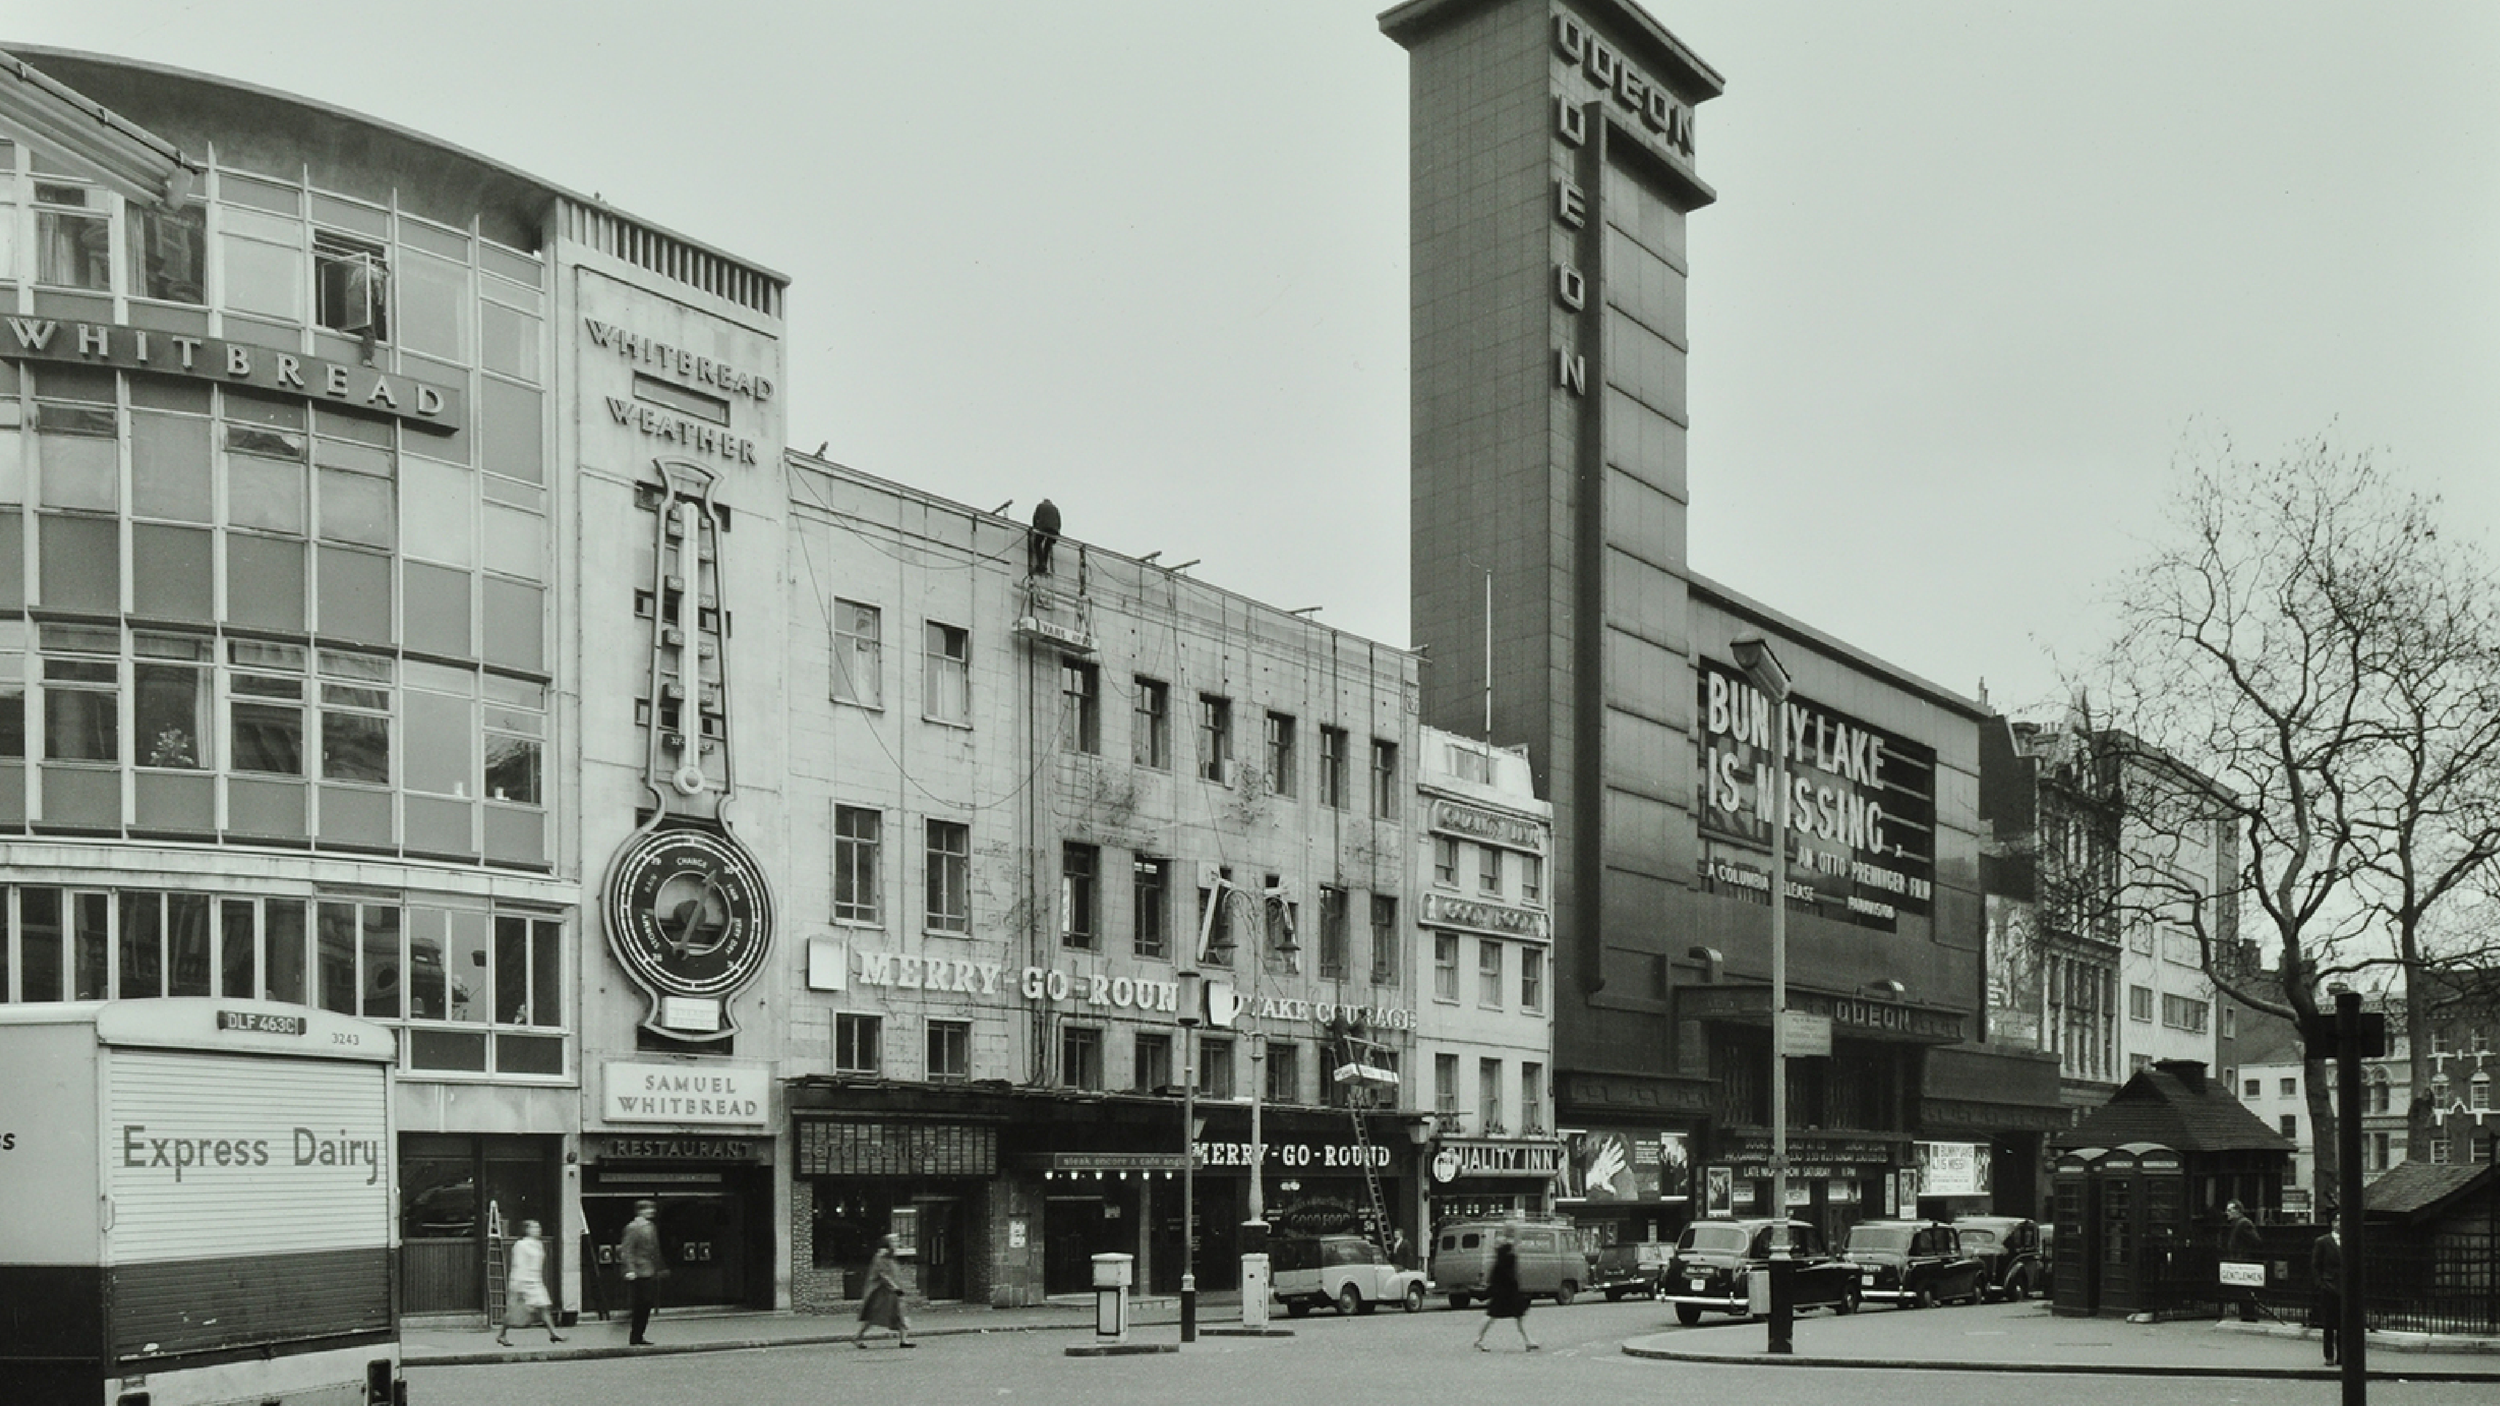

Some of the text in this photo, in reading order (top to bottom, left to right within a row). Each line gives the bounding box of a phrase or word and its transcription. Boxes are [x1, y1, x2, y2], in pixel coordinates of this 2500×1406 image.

[1558, 12, 1695, 157] ODEON
[8, 317, 446, 416] WHITBREAD
[585, 317, 775, 401] WHITBREAD
[606, 395, 757, 466] WEATHER
[1816, 714, 1884, 789] LAKE
[1708, 746, 1740, 812] IS
[676, 856, 708, 868] CHANGE
[1819, 851, 1846, 877] OTTO
[641, 913, 660, 949] STORMY
[228, 1013, 296, 1033] DLF 463C
[1836, 1001, 1912, 1032] ODEON
[332, 1033, 360, 1046] 3243
[645, 1074, 737, 1094] SAMUEL
[617, 1096, 758, 1117] WHITBREAD
[123, 1124, 379, 1186] Express Dairy
[616, 1139, 753, 1158] RESTAURANT
[1525, 1148, 1554, 1171] INN
